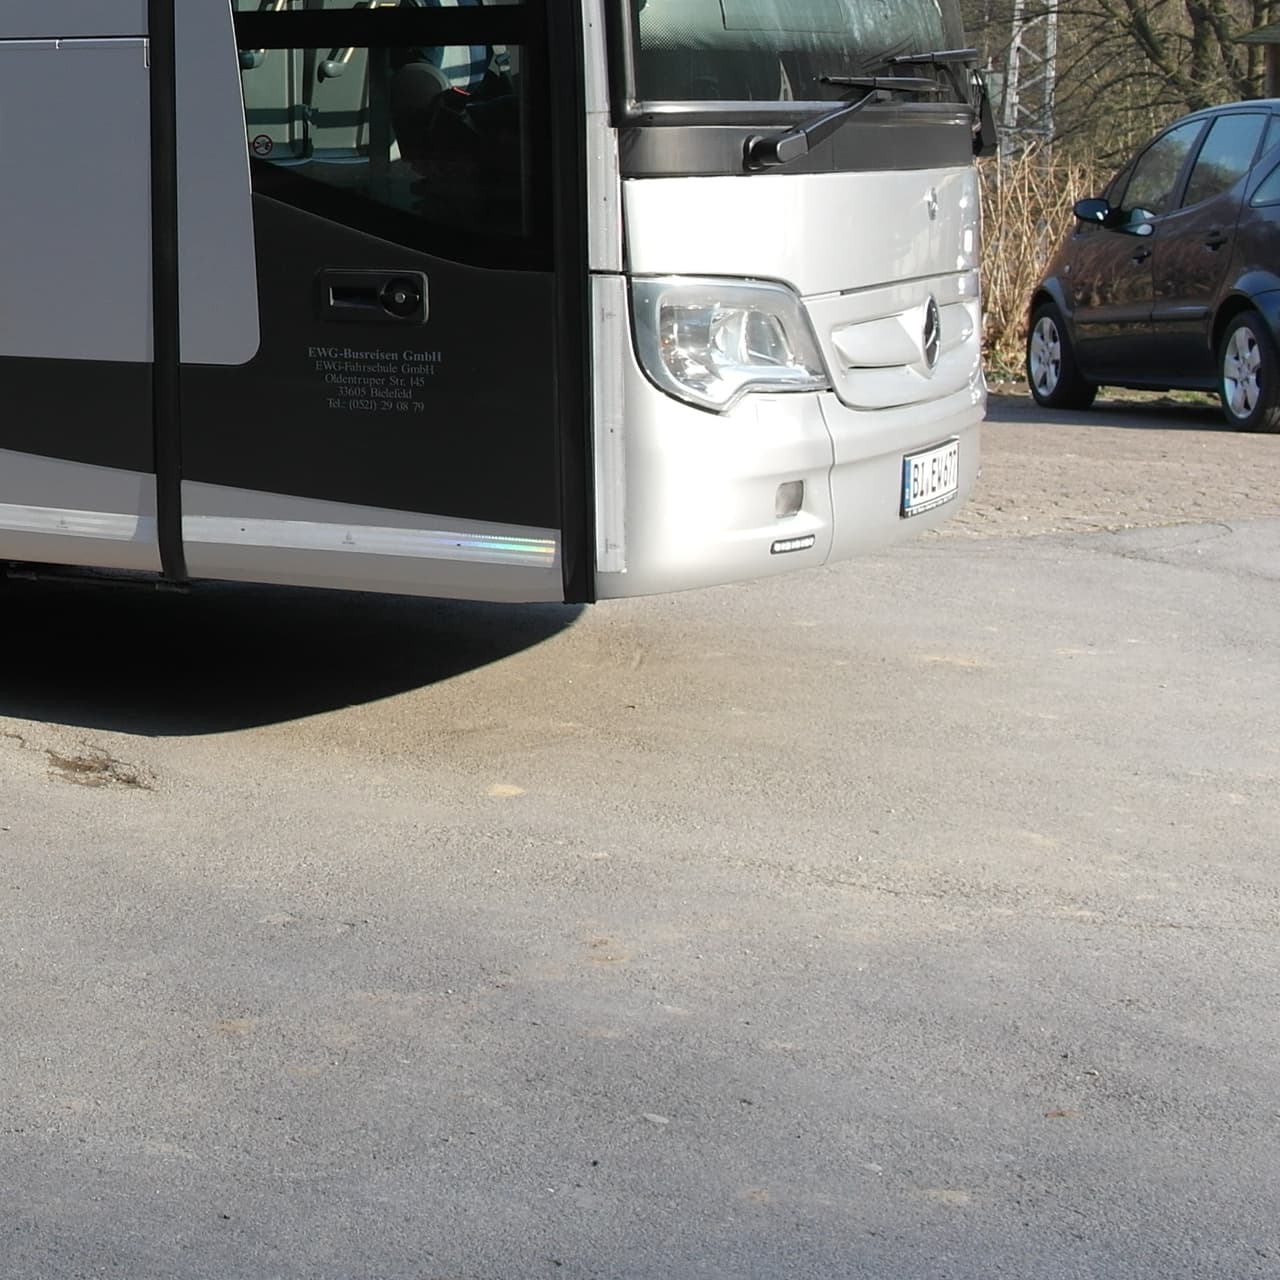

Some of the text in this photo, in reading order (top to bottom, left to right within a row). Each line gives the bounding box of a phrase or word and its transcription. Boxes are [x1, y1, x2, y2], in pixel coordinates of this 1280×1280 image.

[308, 346, 442, 362] EWG-Busreisen GmbH
[315, 360, 435, 375] EWG-Fahrschule GmbH
[324, 373, 386, 387] Oldentruper
[389, 375, 406, 386] Str.
[338, 387, 412, 399] 33605 Bielefeld
